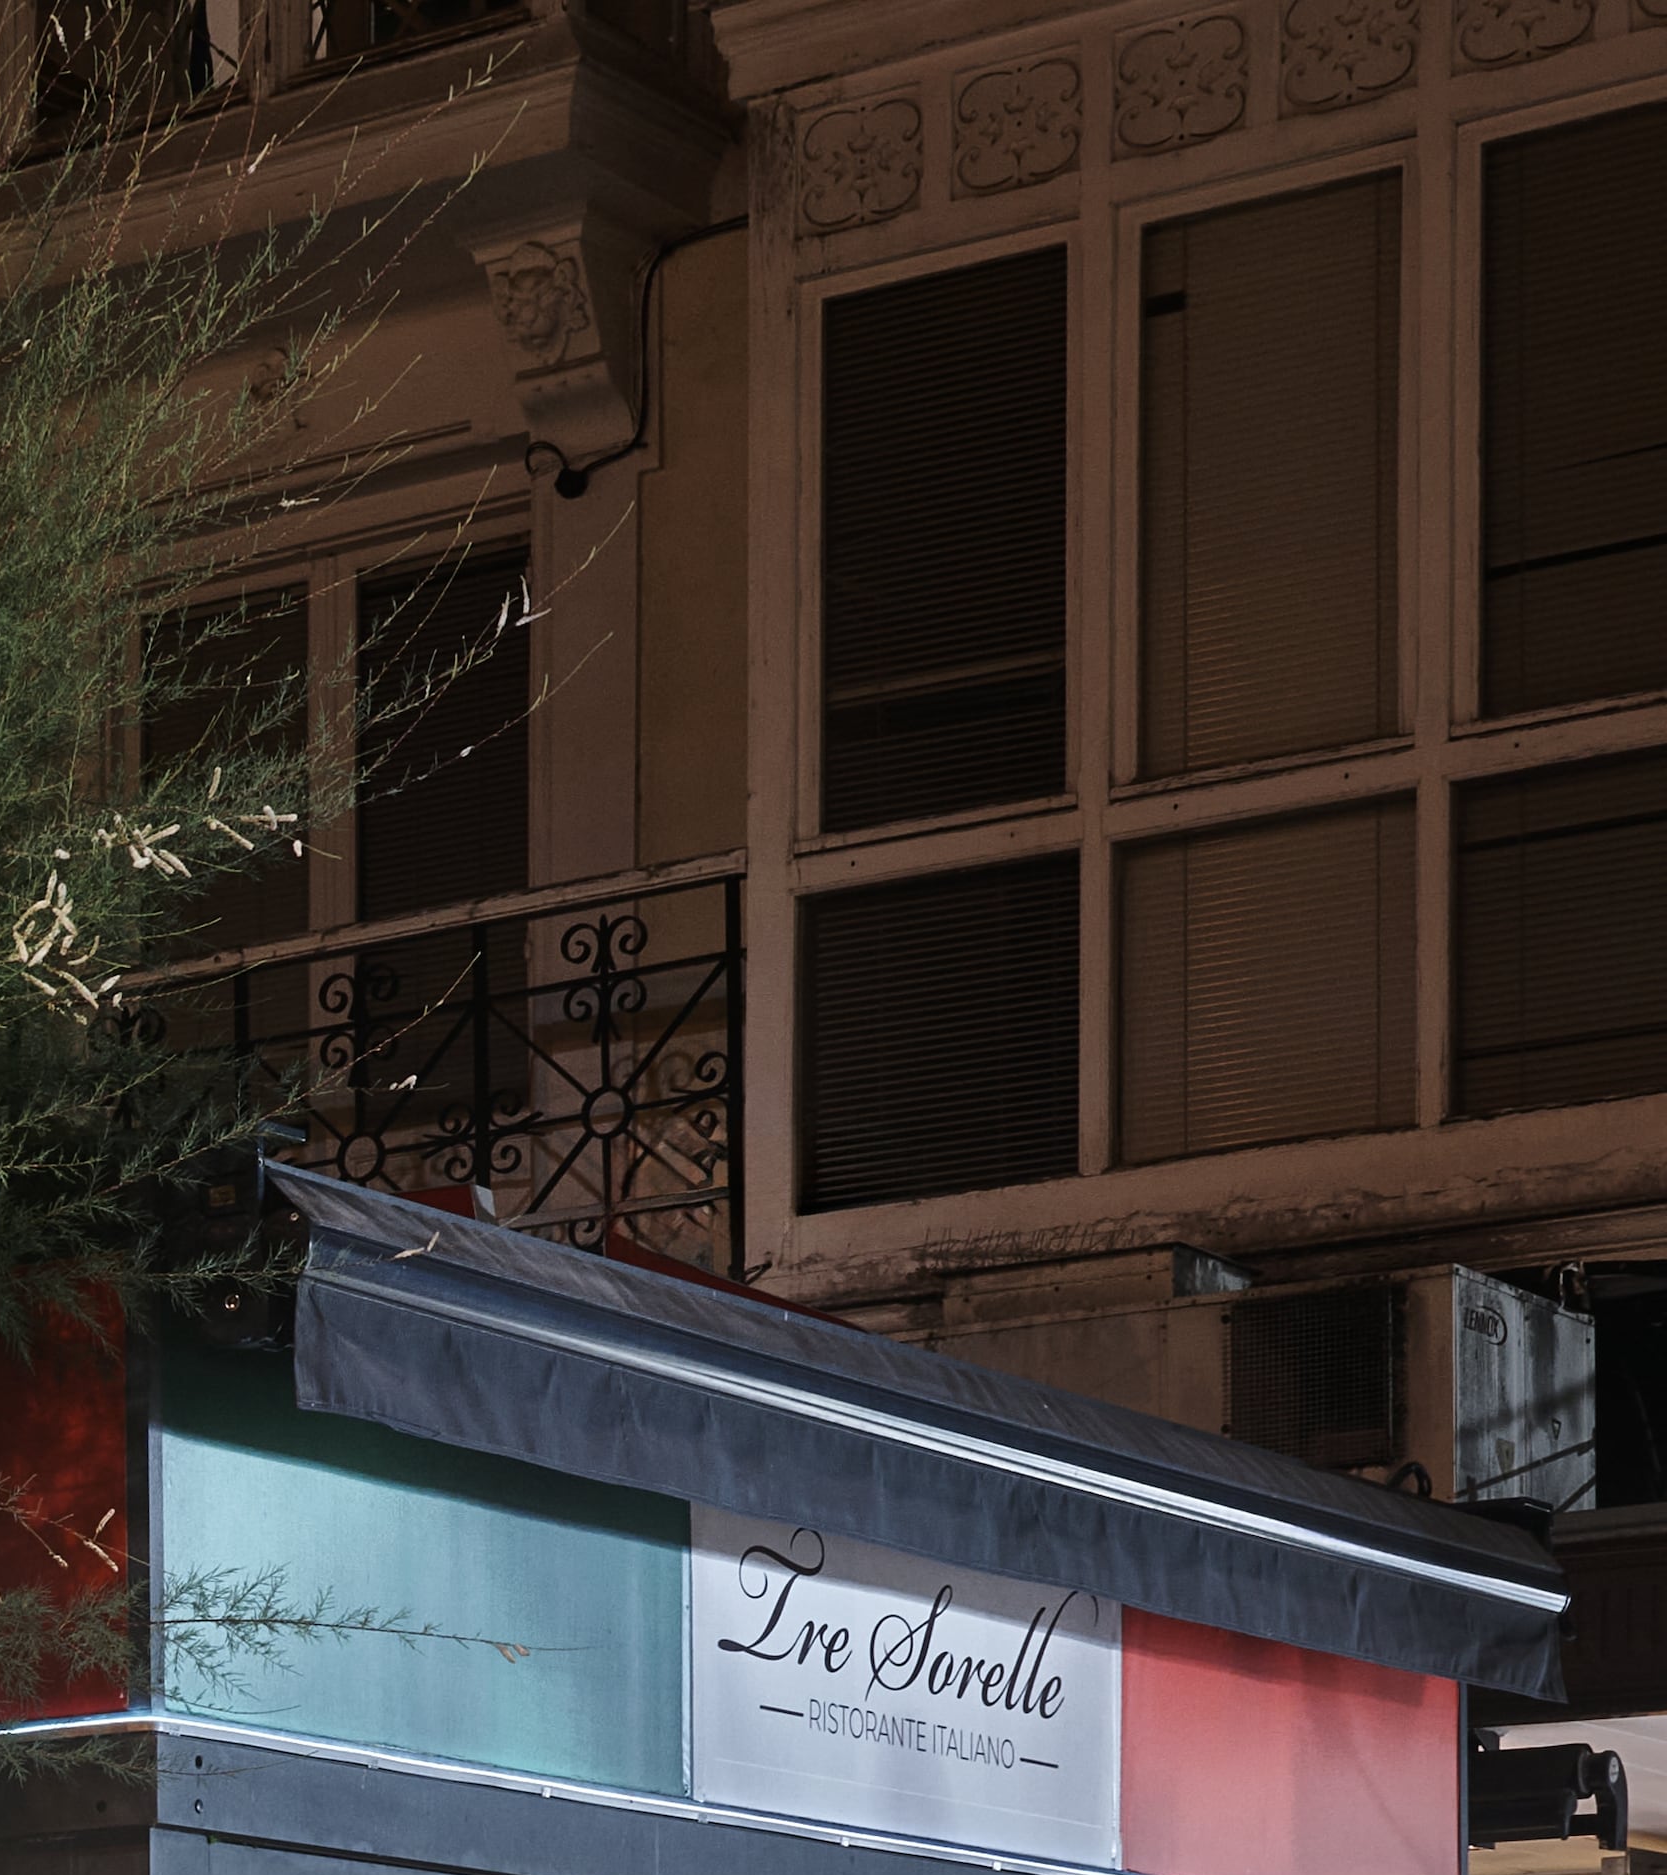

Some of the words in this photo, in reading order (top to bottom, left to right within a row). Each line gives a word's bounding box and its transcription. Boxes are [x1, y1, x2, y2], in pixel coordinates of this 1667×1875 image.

[717, 1527, 853, 1674] Tre
[865, 1584, 1099, 1720] Sorelle
[809, 1698, 928, 1753] RISTORANTE
[931, 1723, 1015, 1770] ITALIANO
